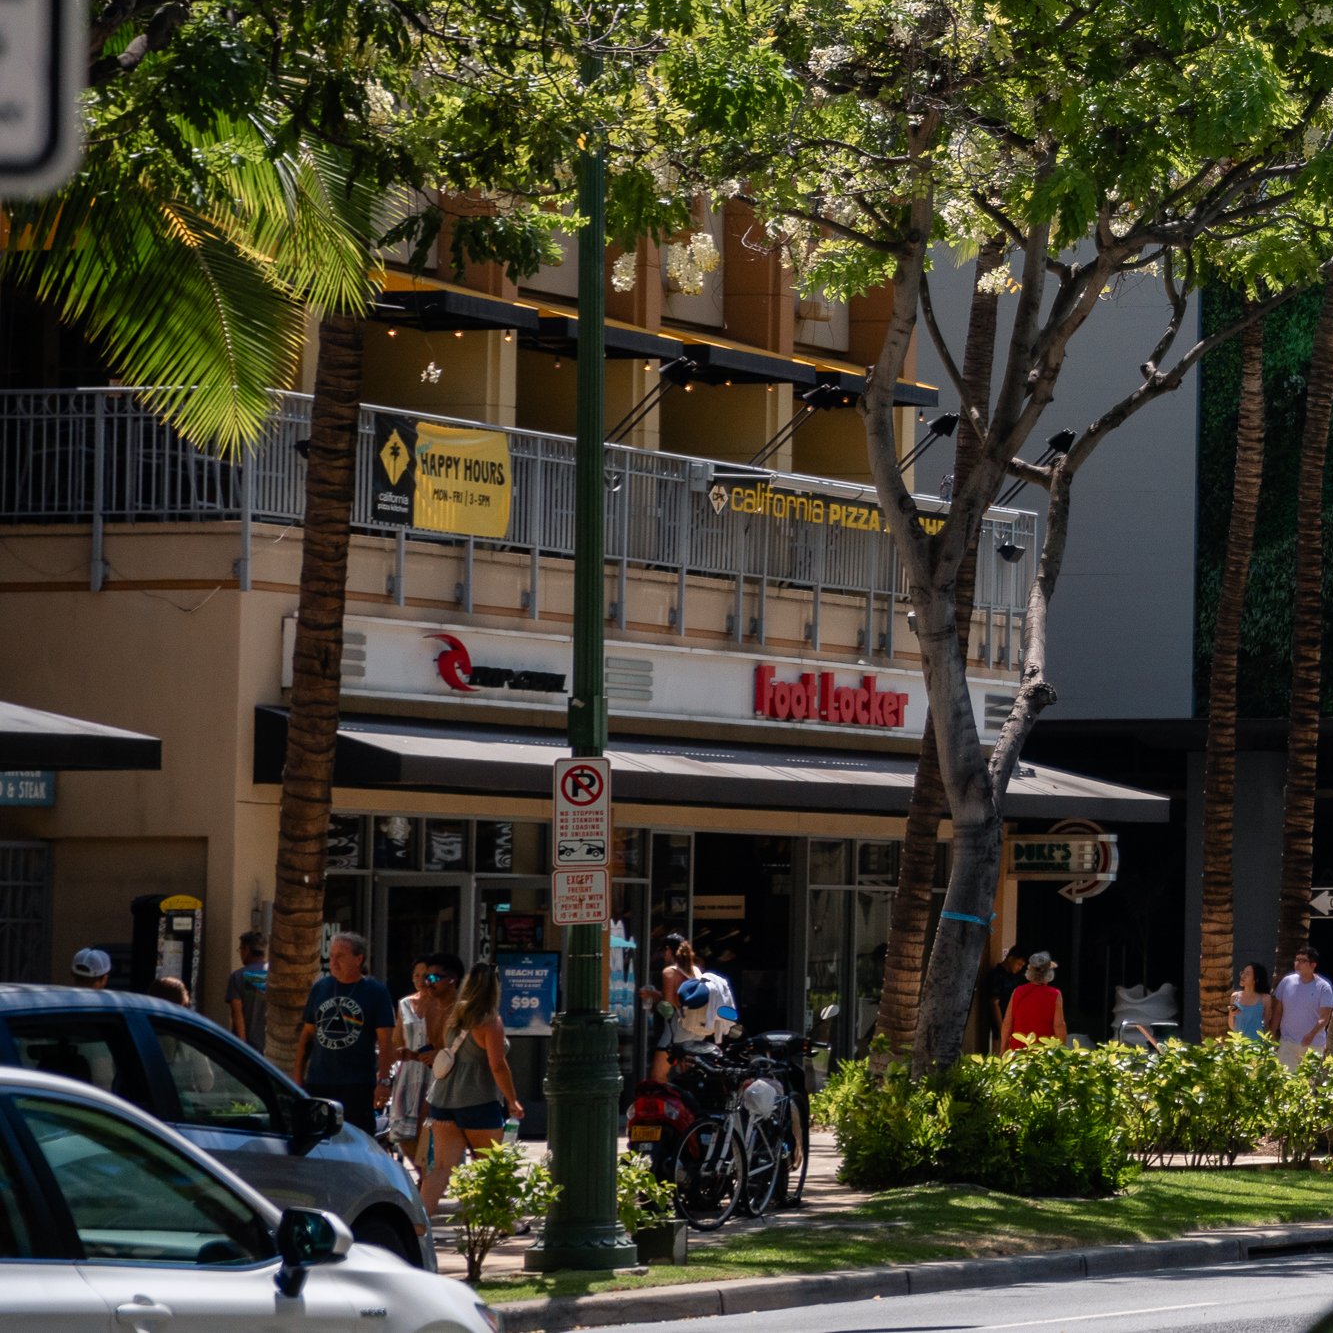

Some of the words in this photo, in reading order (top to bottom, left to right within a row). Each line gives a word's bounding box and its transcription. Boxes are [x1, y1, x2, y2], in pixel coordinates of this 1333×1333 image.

[421, 453, 461, 480] HAPPY
[464, 458, 505, 486] HOURS
[379, 491, 409, 505] california
[730, 482, 824, 524] california
[828, 504, 881, 532] PIZZA
[755, 665, 819, 719] Foot
[819, 672, 909, 728] Locker
[7, 782, 15, 798] &
[18, 781, 47, 799] STEAK
[1014, 842, 1072, 861] DUKE'S
[567, 874, 594, 885] EXCEPT
[567, 885, 593, 893] FREIGHT
[505, 969, 533, 977] BEACH
[535, 969, 549, 977] KIT
[512, 995, 540, 1010] $99
